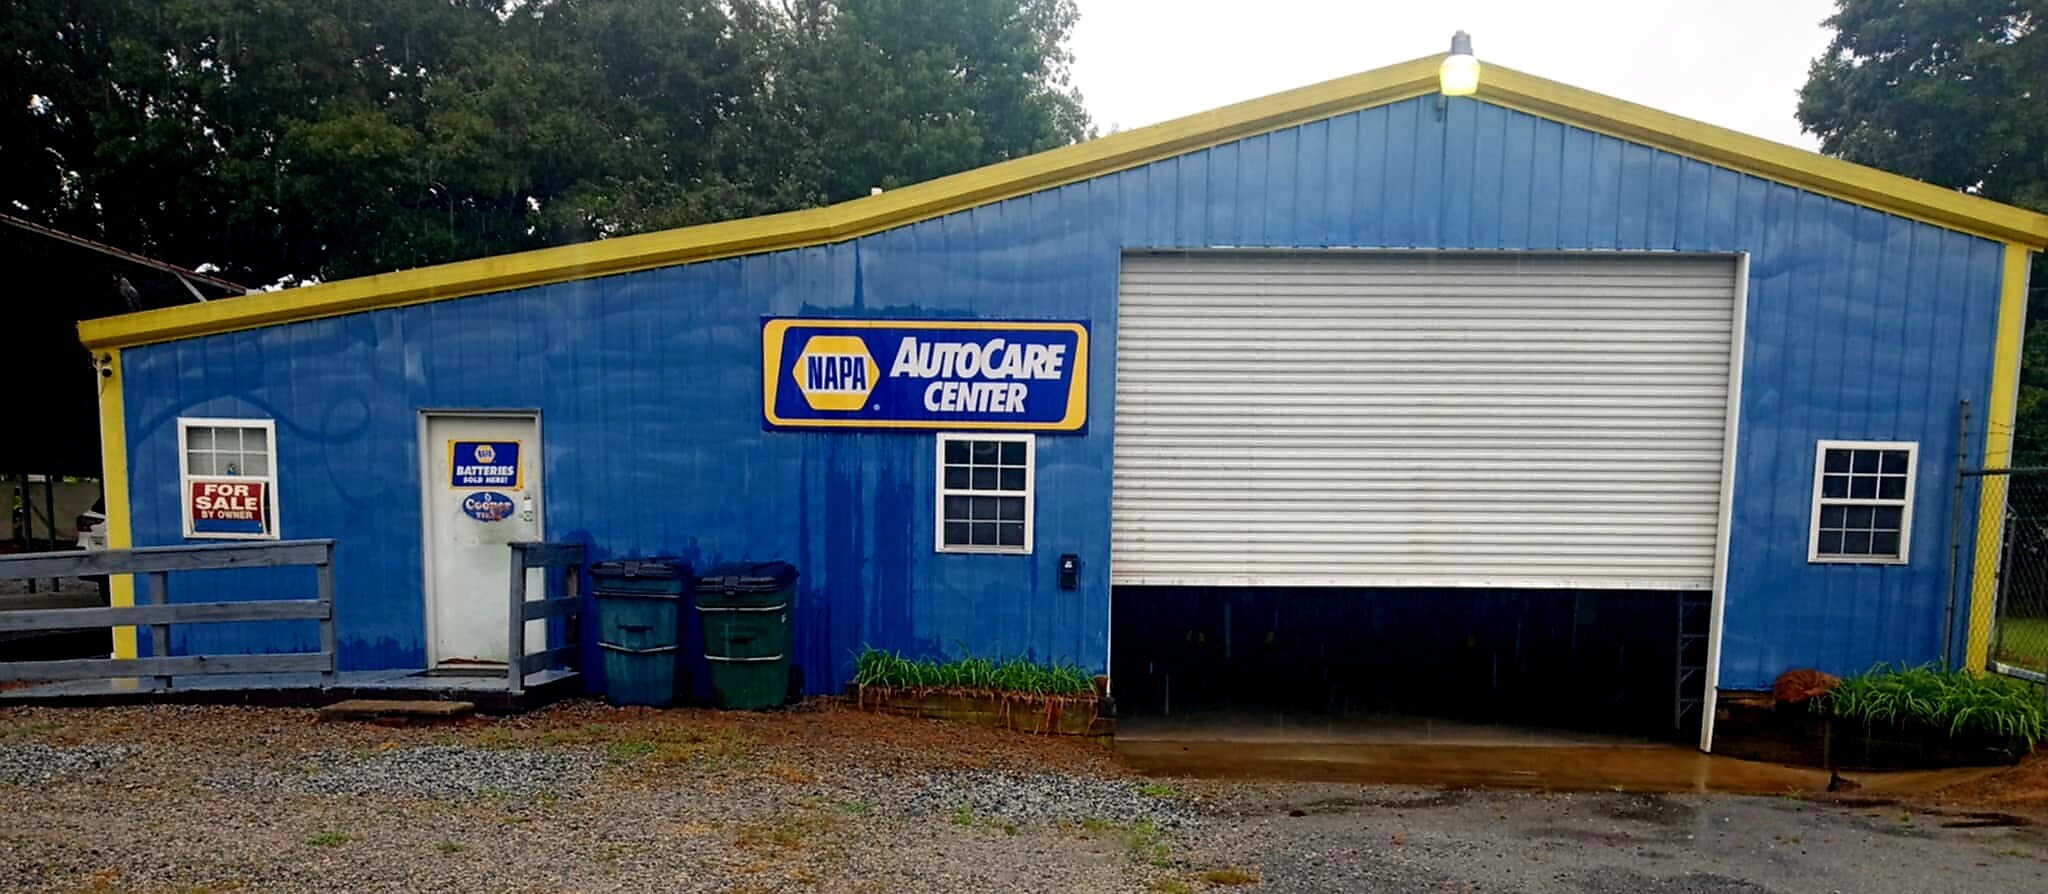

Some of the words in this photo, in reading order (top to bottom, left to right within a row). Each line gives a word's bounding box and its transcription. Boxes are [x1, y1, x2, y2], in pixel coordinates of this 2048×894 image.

[889, 336, 1067, 380] AUTOCARE
[807, 355, 868, 391] NAPA
[923, 381, 1029, 413] CENTER
[455, 465, 515, 476] BATTERIES
[204, 484, 249, 497] FOR
[195, 496, 259, 511] SALE
[201, 510, 215, 519] BY
[217, 510, 253, 520] OWNER
